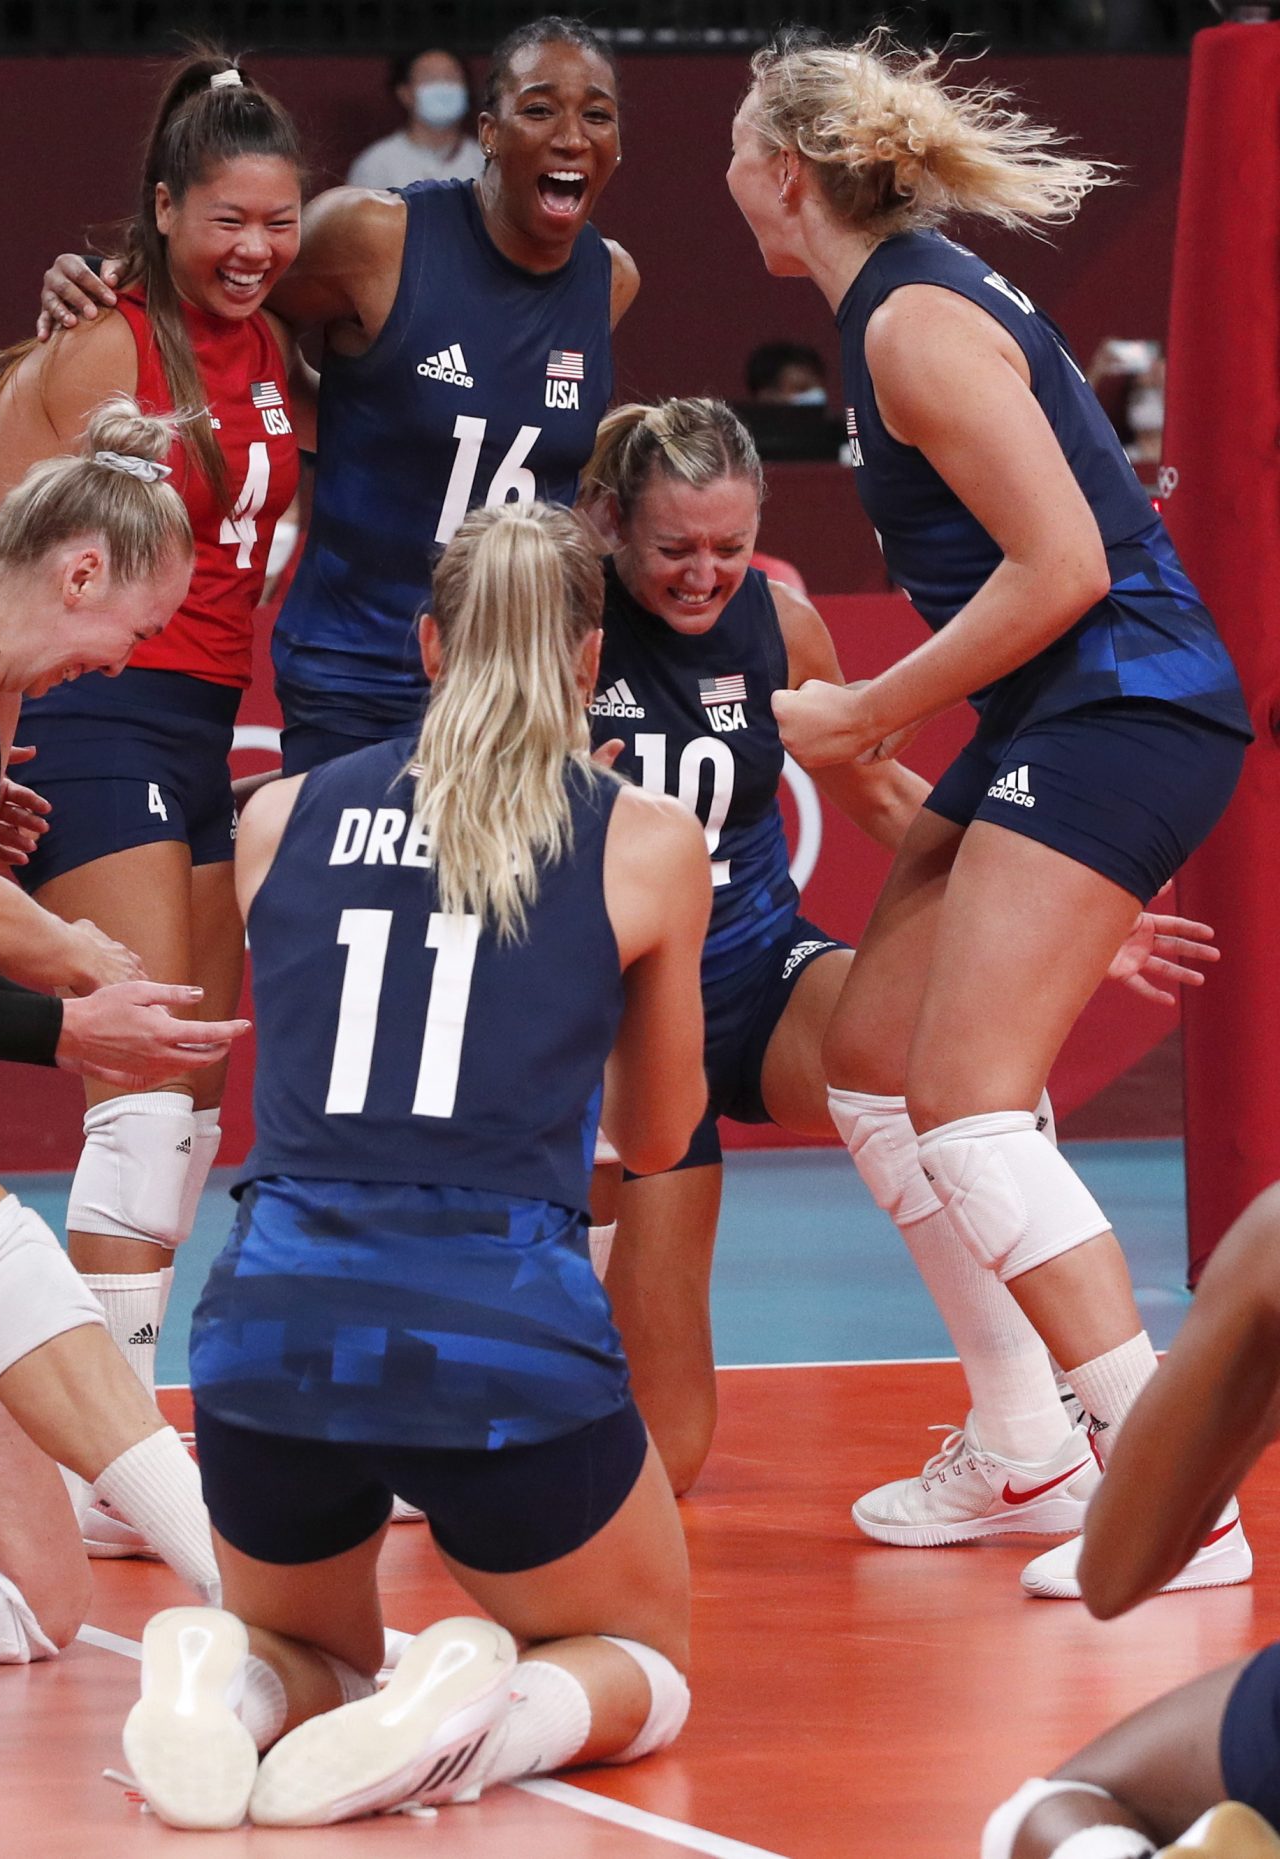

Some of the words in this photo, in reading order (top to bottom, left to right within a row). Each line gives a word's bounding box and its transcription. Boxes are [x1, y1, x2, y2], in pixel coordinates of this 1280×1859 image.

[416, 362, 474, 388] adidas
[544, 379, 579, 410] USA
[261, 408, 293, 435] USA
[434, 414, 542, 545] 16
[219, 441, 270, 569] 4
[588, 701, 645, 719] adidas
[705, 703, 748, 732] USA
[148, 782, 168, 821] 4
[987, 785, 1036, 808] adidas
[325, 908, 480, 1118] 11
